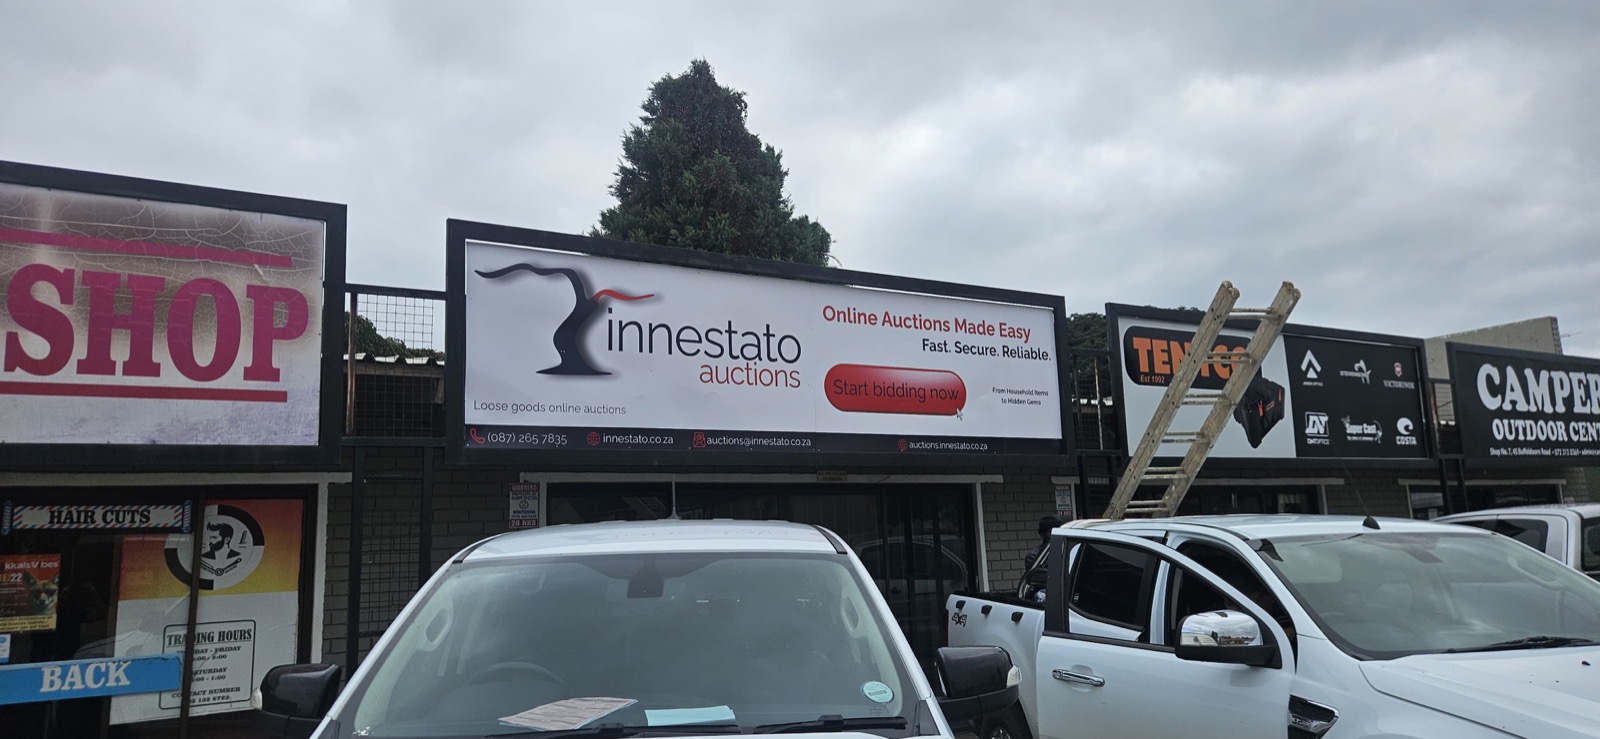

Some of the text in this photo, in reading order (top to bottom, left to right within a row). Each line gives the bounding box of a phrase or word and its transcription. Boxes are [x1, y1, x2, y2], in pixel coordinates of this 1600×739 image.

[4, 263, 309, 383] SHOP
[822, 305, 1031, 344] Online Auctions Made Easy
[607, 307, 802, 365] innestato
[922, 338, 1052, 361] Fast. Secure. Reliable.
[1132, 336, 1248, 380] TENC
[699, 362, 801, 389] auctions
[1140, 374, 1165, 384] Est 1992
[833, 379, 959, 403] Start bidding now
[1006, 388, 1034, 396] Household
[1034, 389, 1049, 397] Items
[473, 400, 627, 415] Loose goods online auctions
[1492, 418, 1568, 442] OUTDOOR
[487, 432, 568, 446] (087) 265 7835
[602, 432, 674, 445] innestato.co.za
[706, 436, 812, 448] auctions@innestato.co.za
[908, 441, 988, 451] auctions.innestato.co.za
[1395, 436, 1417, 445] COSTA
[48, 509, 151, 525] HAIR CUTS
[166, 628, 252, 646] TRAING HOURS
[214, 645, 242, 653] FRIDAY
[39, 660, 131, 693] BACK
[192, 666, 227, 675] ATURDAY
[171, 686, 241, 698] COTACT NUMBER
